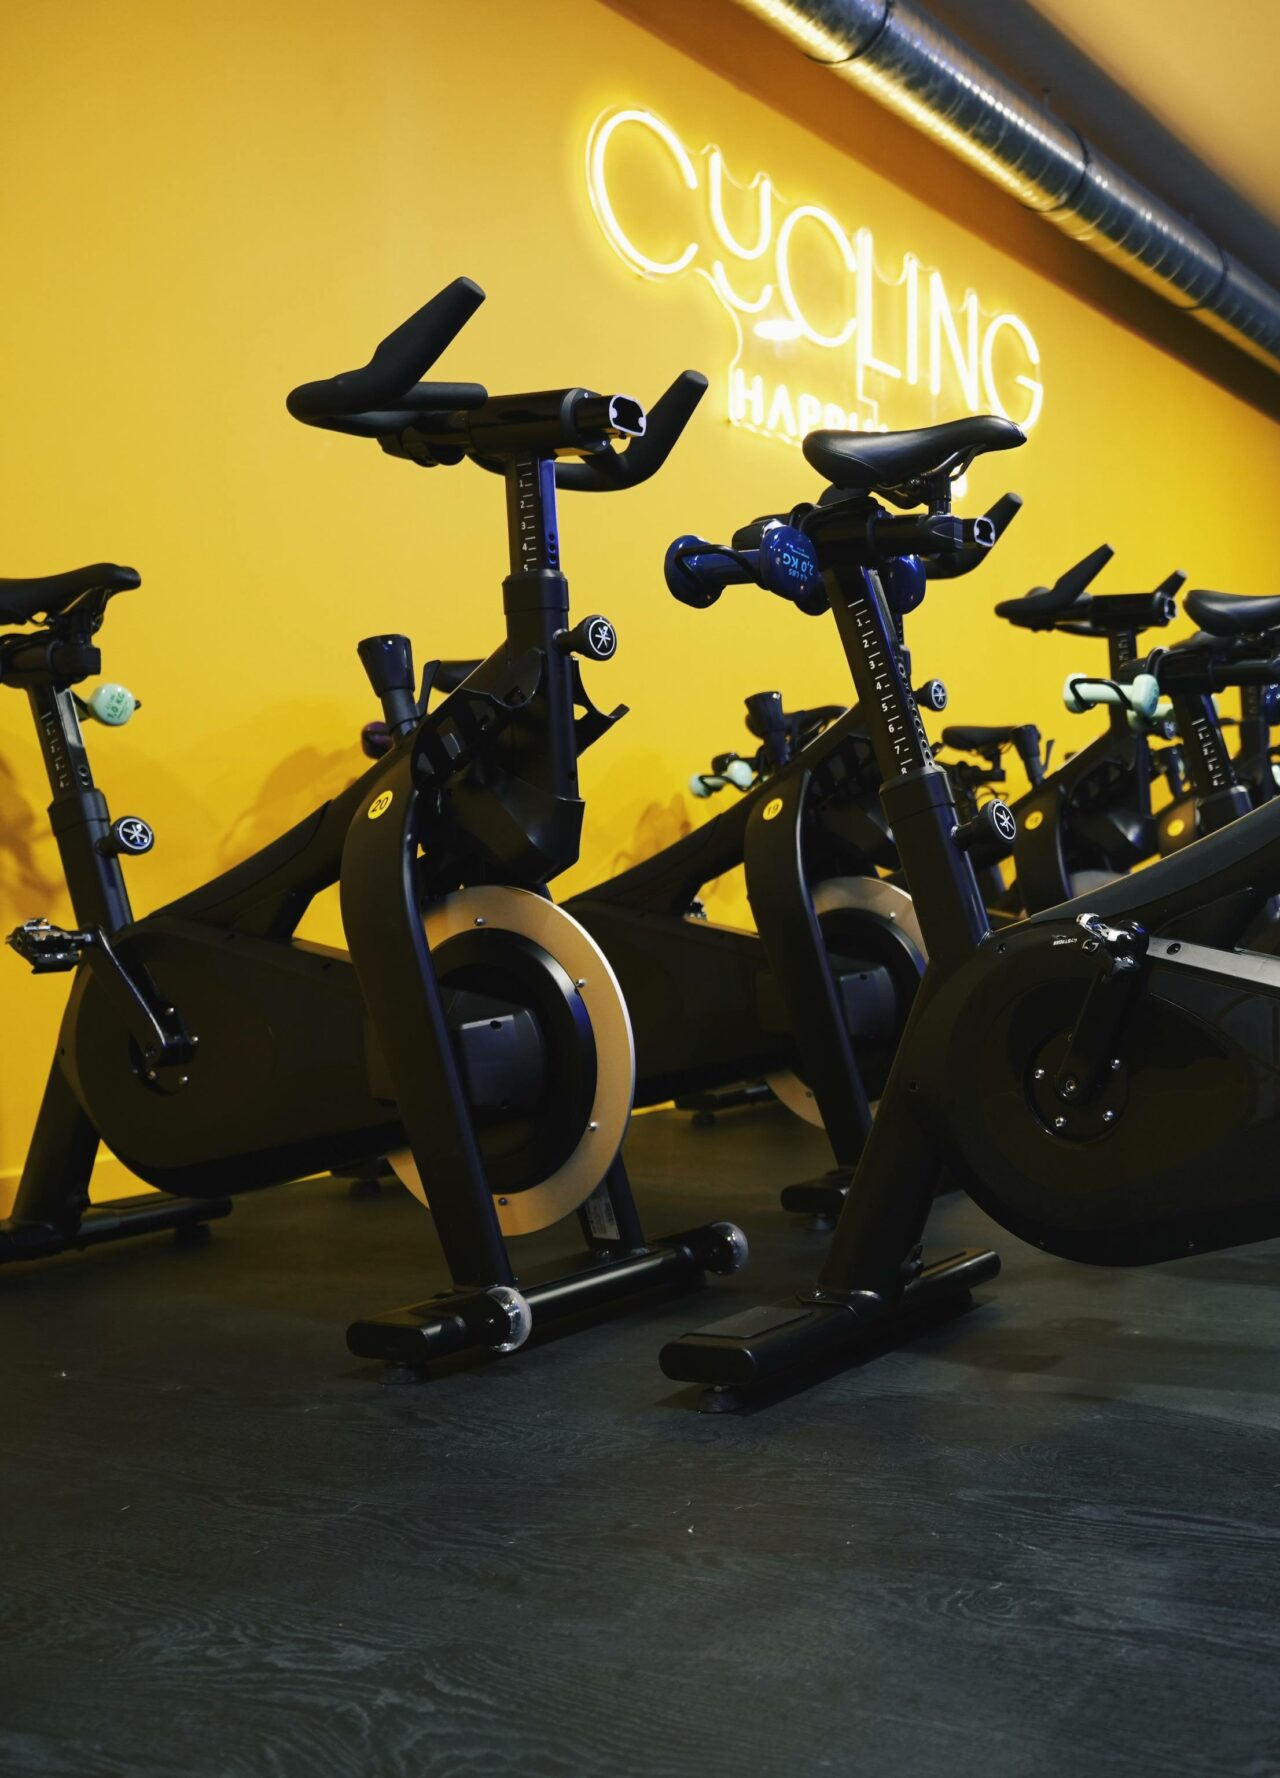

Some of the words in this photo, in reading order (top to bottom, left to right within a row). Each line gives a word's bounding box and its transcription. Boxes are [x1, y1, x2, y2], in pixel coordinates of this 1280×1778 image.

[592, 108, 1043, 433] CYCLING
[519, 479, 524, 488] 1
[520, 500, 525, 509] 2
[521, 521, 526, 530] 3
[522, 542, 527, 551] 4
[782, 552, 799, 569] KG
[856, 618, 863, 627] 1
[862, 639, 869, 649] 2
[869, 660, 876, 670] 3
[876, 681, 882, 691] 4
[881, 703, 888, 712] 5
[888, 724, 895, 733] 6
[894, 745, 900, 755] 7
[371, 796, 389, 812] 20
[767, 802, 780, 815] 19
